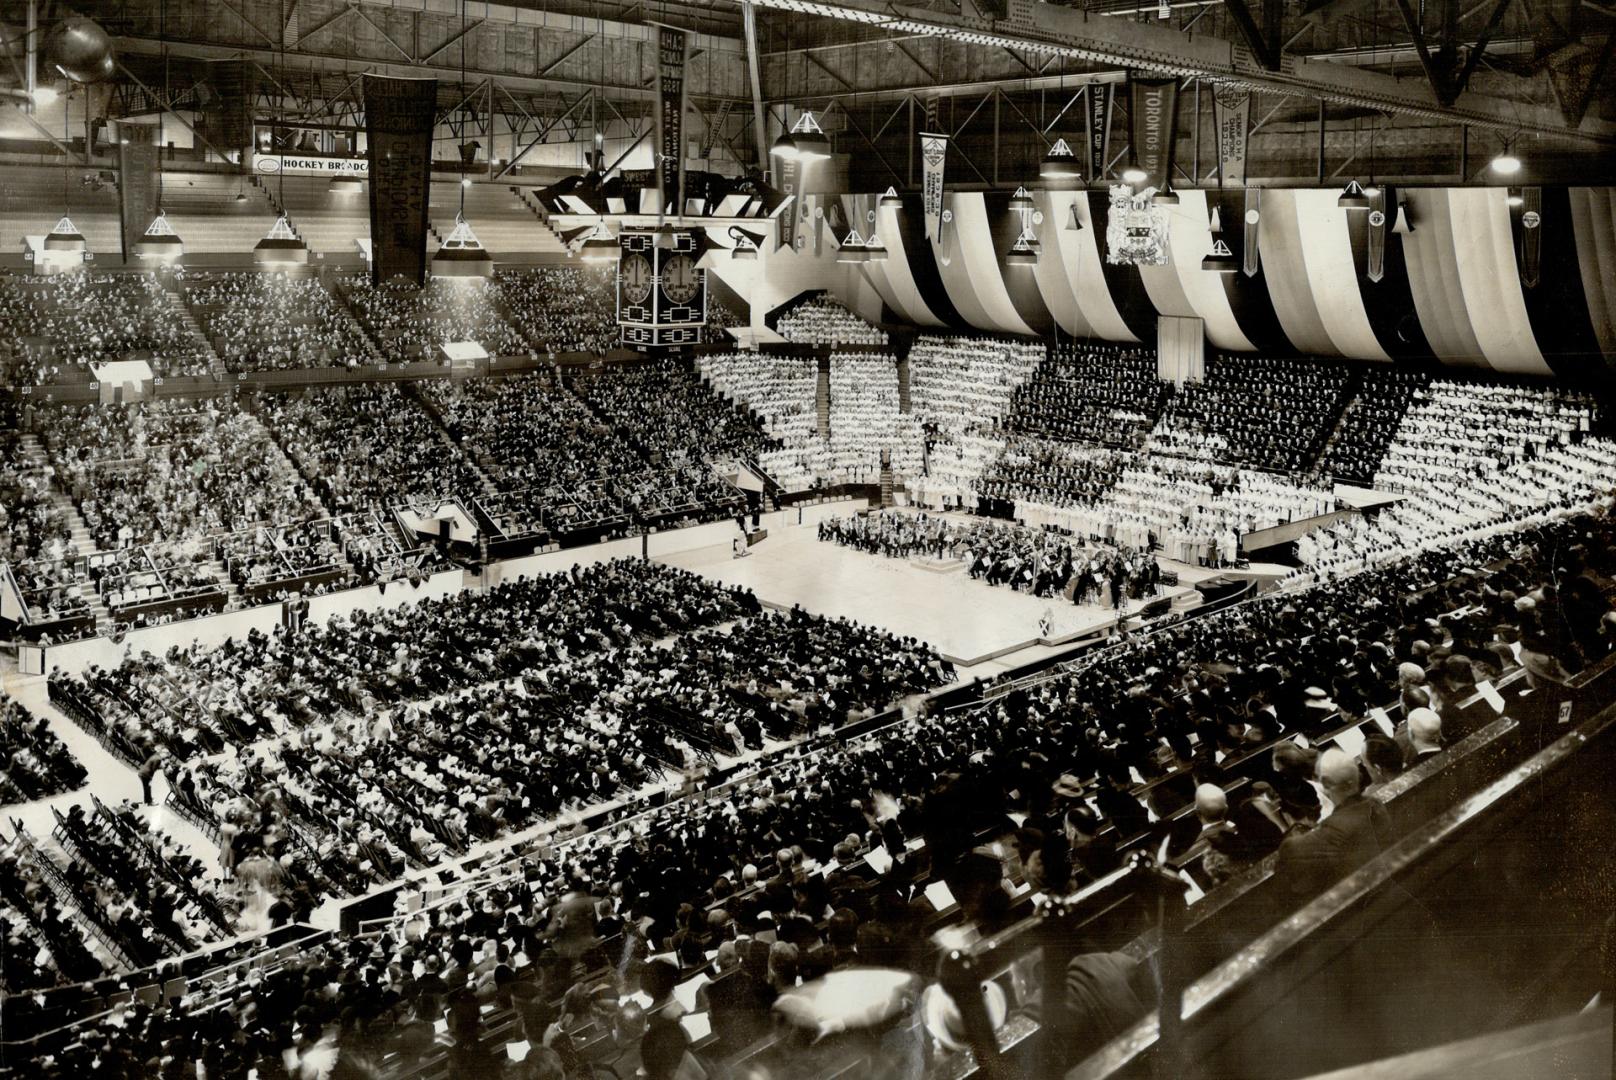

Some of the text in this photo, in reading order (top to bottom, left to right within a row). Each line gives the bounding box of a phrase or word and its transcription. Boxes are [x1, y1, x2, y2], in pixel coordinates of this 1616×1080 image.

[1094, 86, 1104, 131] STANLEY
[1145, 89, 1163, 151] TORONTOS
[1094, 133, 1103, 150] CUP
[283, 159, 325, 169] HOCKEY
